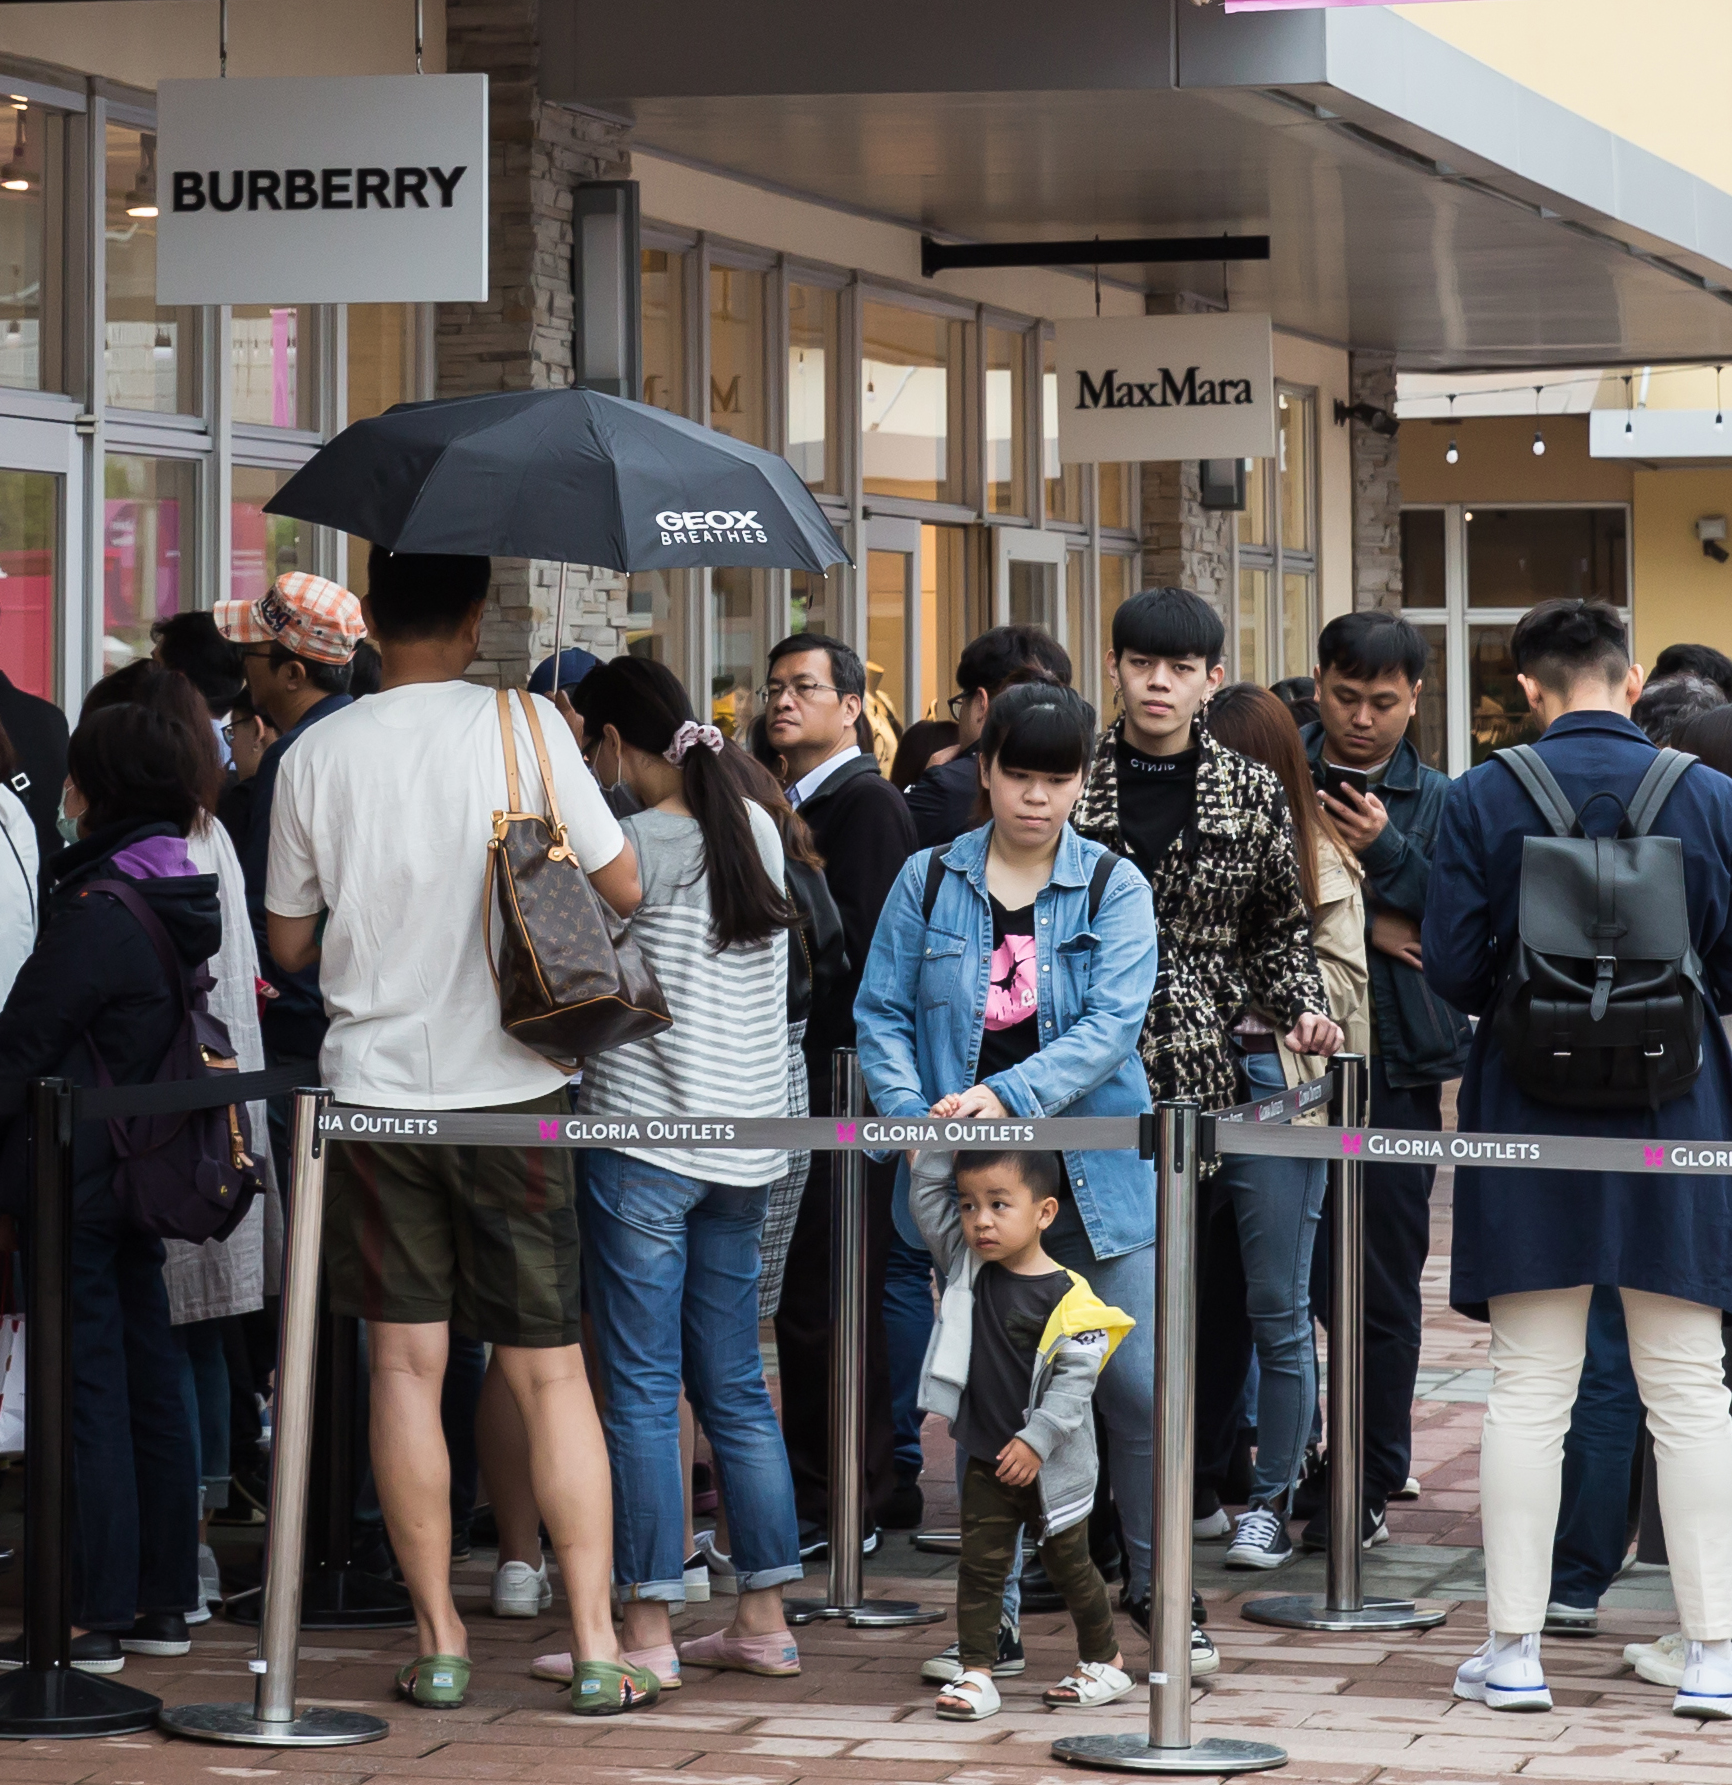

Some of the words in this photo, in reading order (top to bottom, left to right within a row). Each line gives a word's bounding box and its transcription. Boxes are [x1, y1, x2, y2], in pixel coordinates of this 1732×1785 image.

[171, 166, 468, 213] BURBERRY
[1074, 366, 1254, 410] MaxMara
[655, 510, 764, 532] GEOX
[660, 529, 768, 547] BREATHES
[350, 1113, 438, 1135] OUTLETS
[565, 1120, 640, 1140] GLORIA
[646, 1120, 735, 1141] OUTLETS
[862, 1122, 939, 1142] GLORIA
[944, 1122, 1035, 1142] OUTLETS
[1367, 1134, 1444, 1157] GLORIA
[1450, 1138, 1541, 1160] OUTLETS
